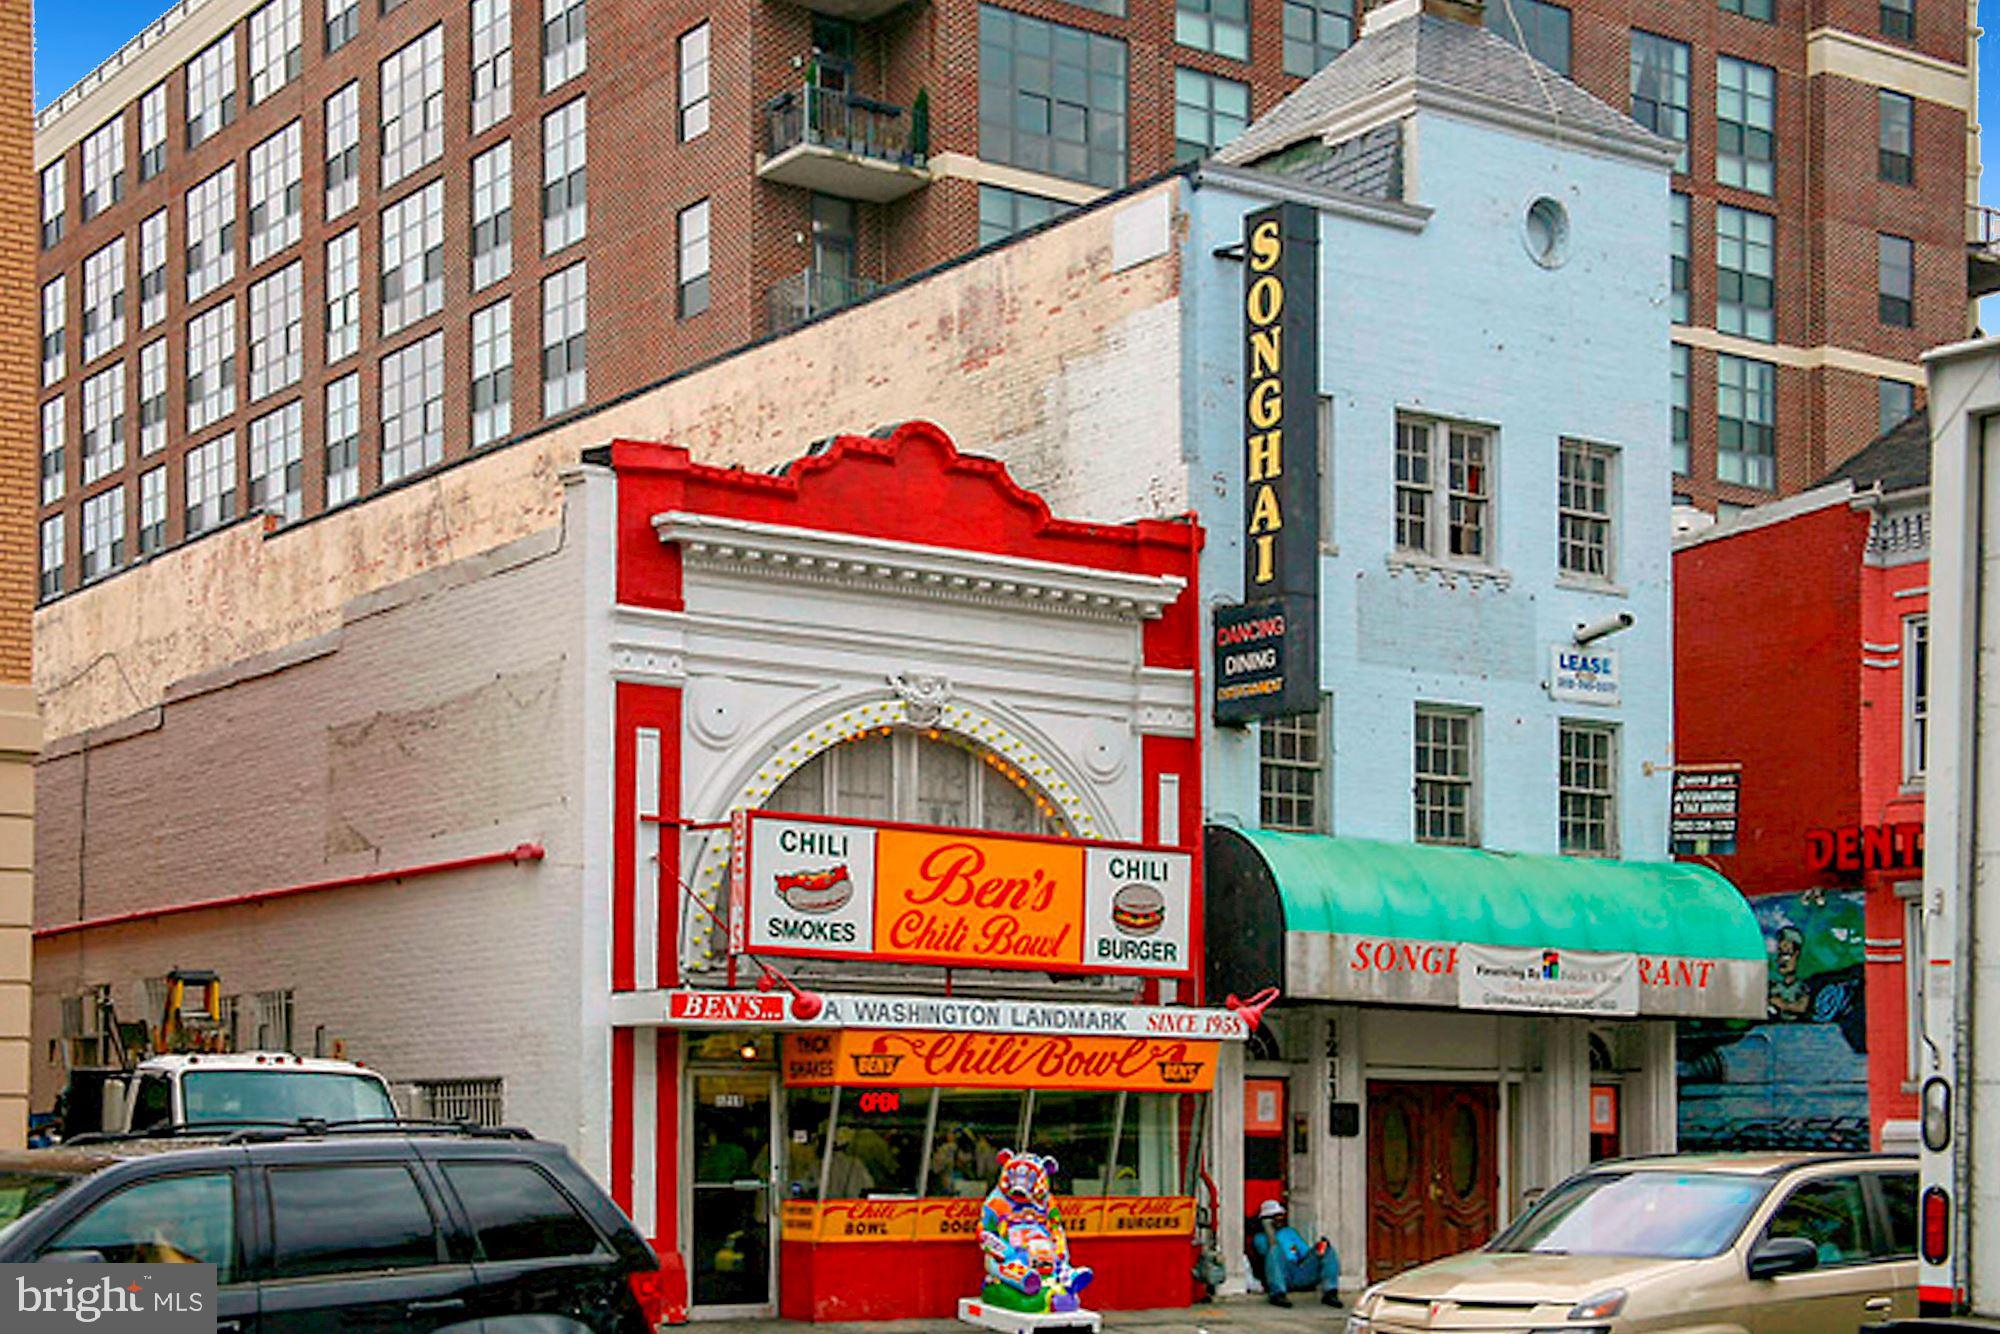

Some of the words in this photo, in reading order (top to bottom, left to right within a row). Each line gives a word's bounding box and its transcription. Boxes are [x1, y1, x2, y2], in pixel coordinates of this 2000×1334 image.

[1247, 220, 1285, 583] SONGHAI
[1217, 615, 1285, 646] DANCING
[1225, 648, 1277, 676] DINING
[780, 829, 848, 857] CHILI
[1804, 822, 1922, 871] DENT
[904, 843, 1056, 912] Ben's
[1109, 858, 1168, 882] CHILI
[768, 917, 855, 942] SMOKES
[890, 909, 969, 950] Chili
[973, 914, 1071, 957] Bowl
[1097, 938, 1178, 962] BURGER
[823, 1004, 841, 1020] A
[855, 1003, 1000, 1027] WASHINGTON
[1011, 1007, 1127, 1031] LANDMARK
[1146, 1013, 1198, 1033] SINCE
[924, 1033, 1036, 1076] Chili
[1036, 1036, 1151, 1077] Bowl
[859, 1092, 900, 1113] OPEN
[845, 1222, 888, 1235] BOWL
[1118, 1217, 1180, 1230] BURGERS
